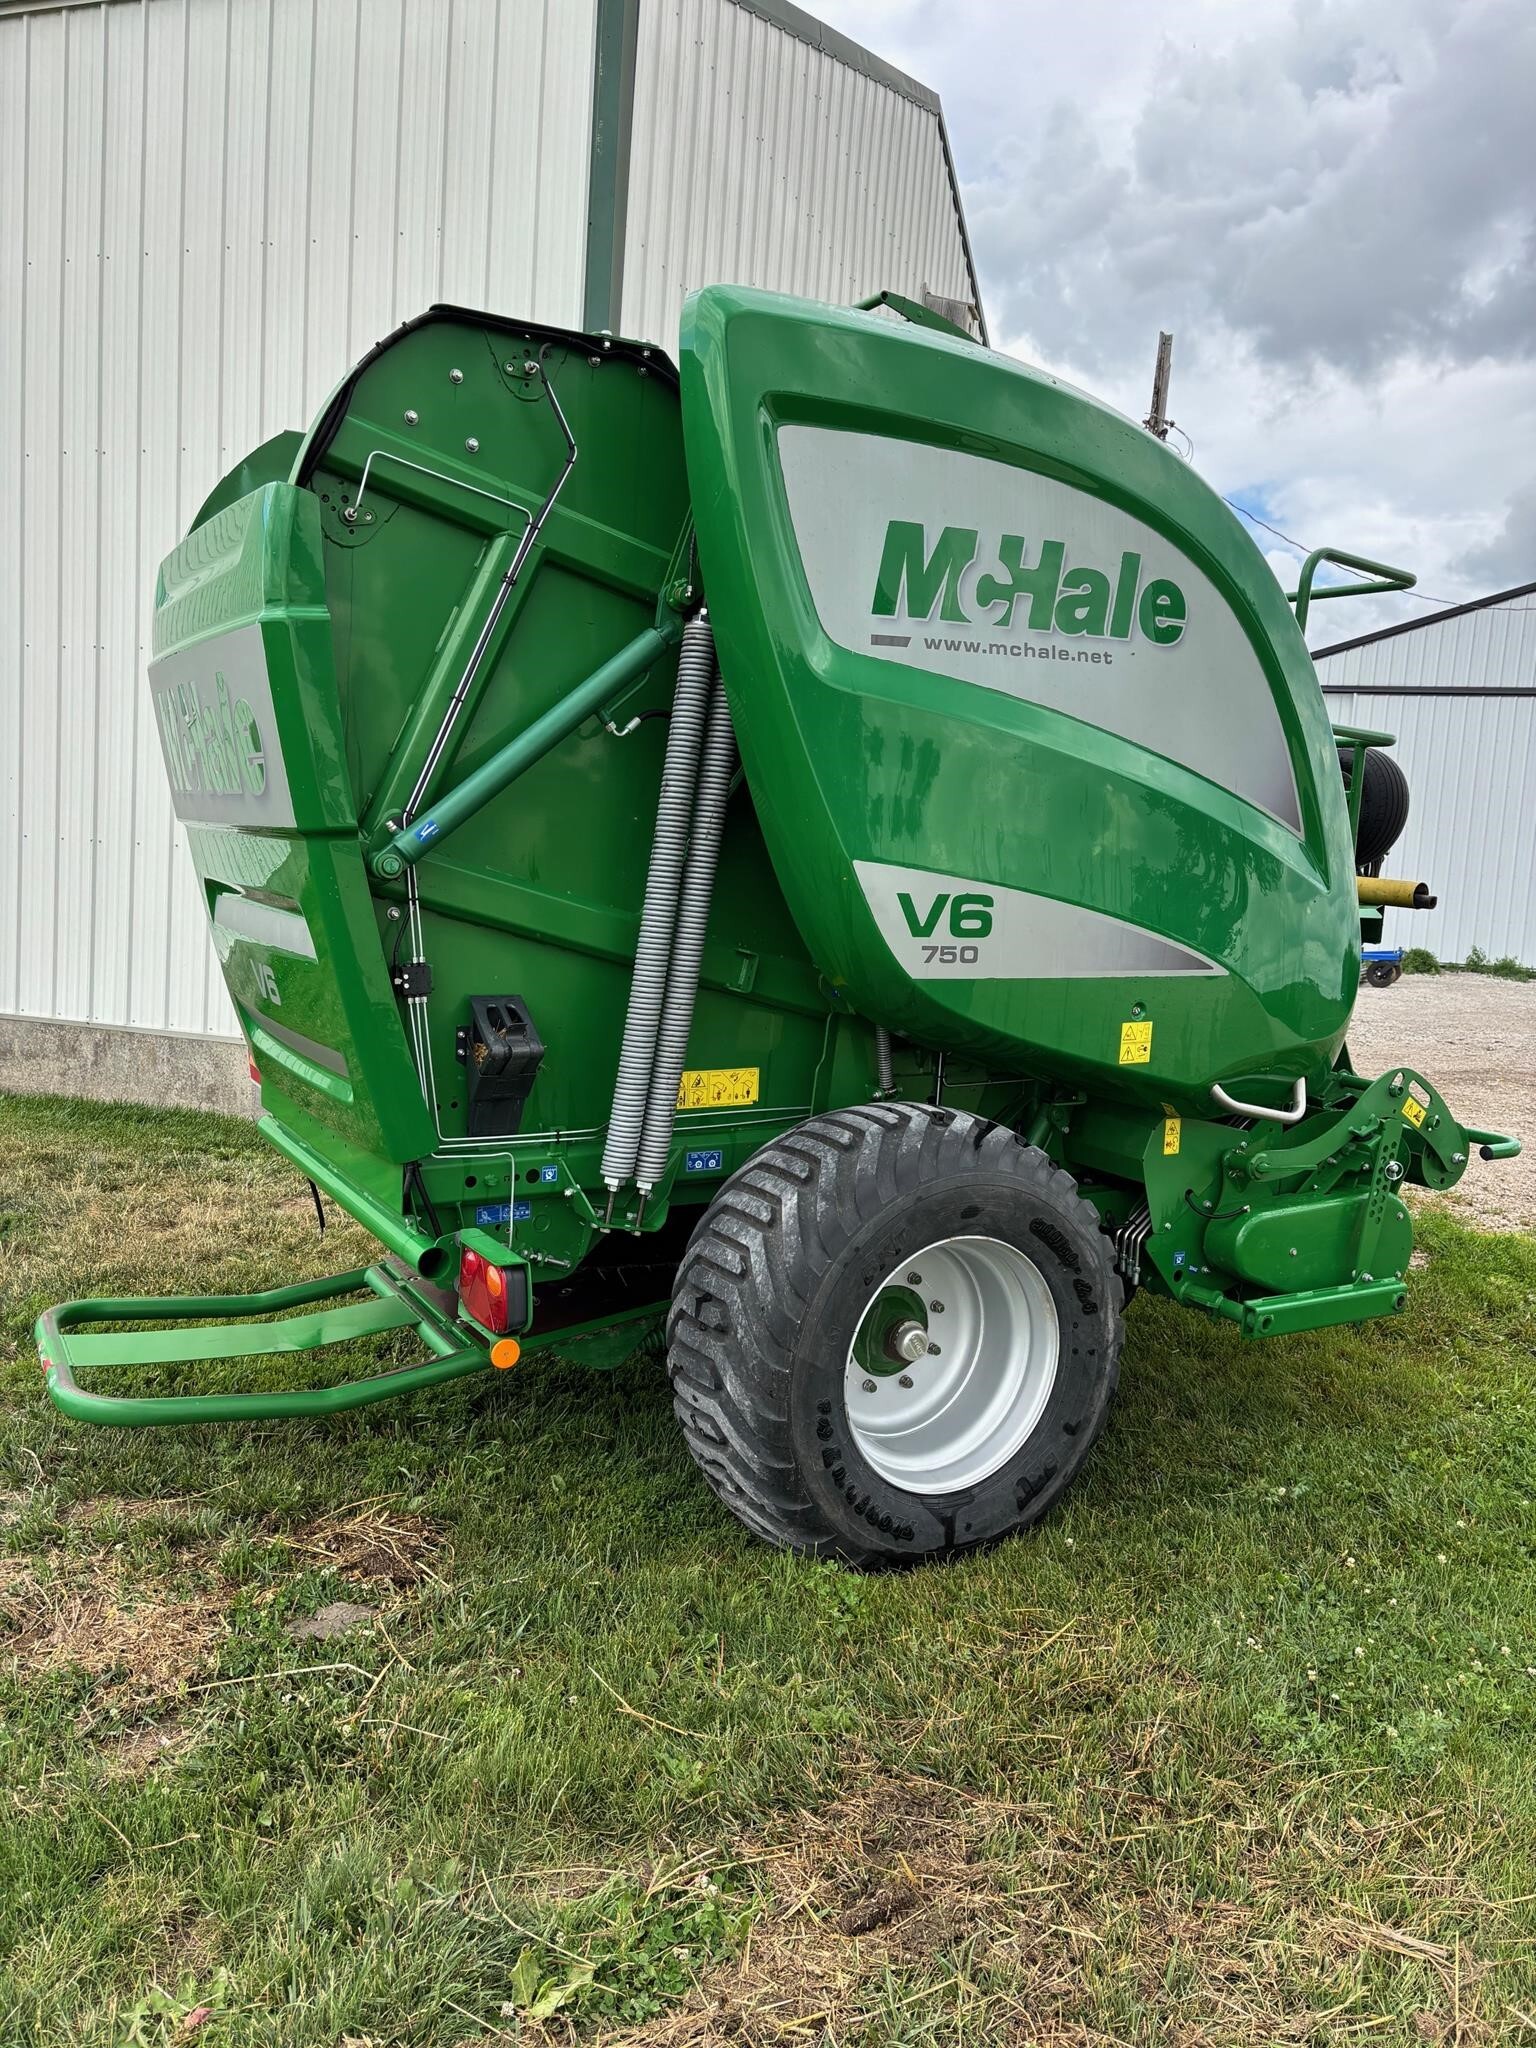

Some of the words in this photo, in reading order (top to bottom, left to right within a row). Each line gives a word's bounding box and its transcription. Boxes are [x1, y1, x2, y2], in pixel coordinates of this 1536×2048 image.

[923, 636, 1113, 665] www.mchale.net
[896, 892, 995, 938] V6
[921, 945, 979, 964] 750
[249, 958, 282, 1006] V6
